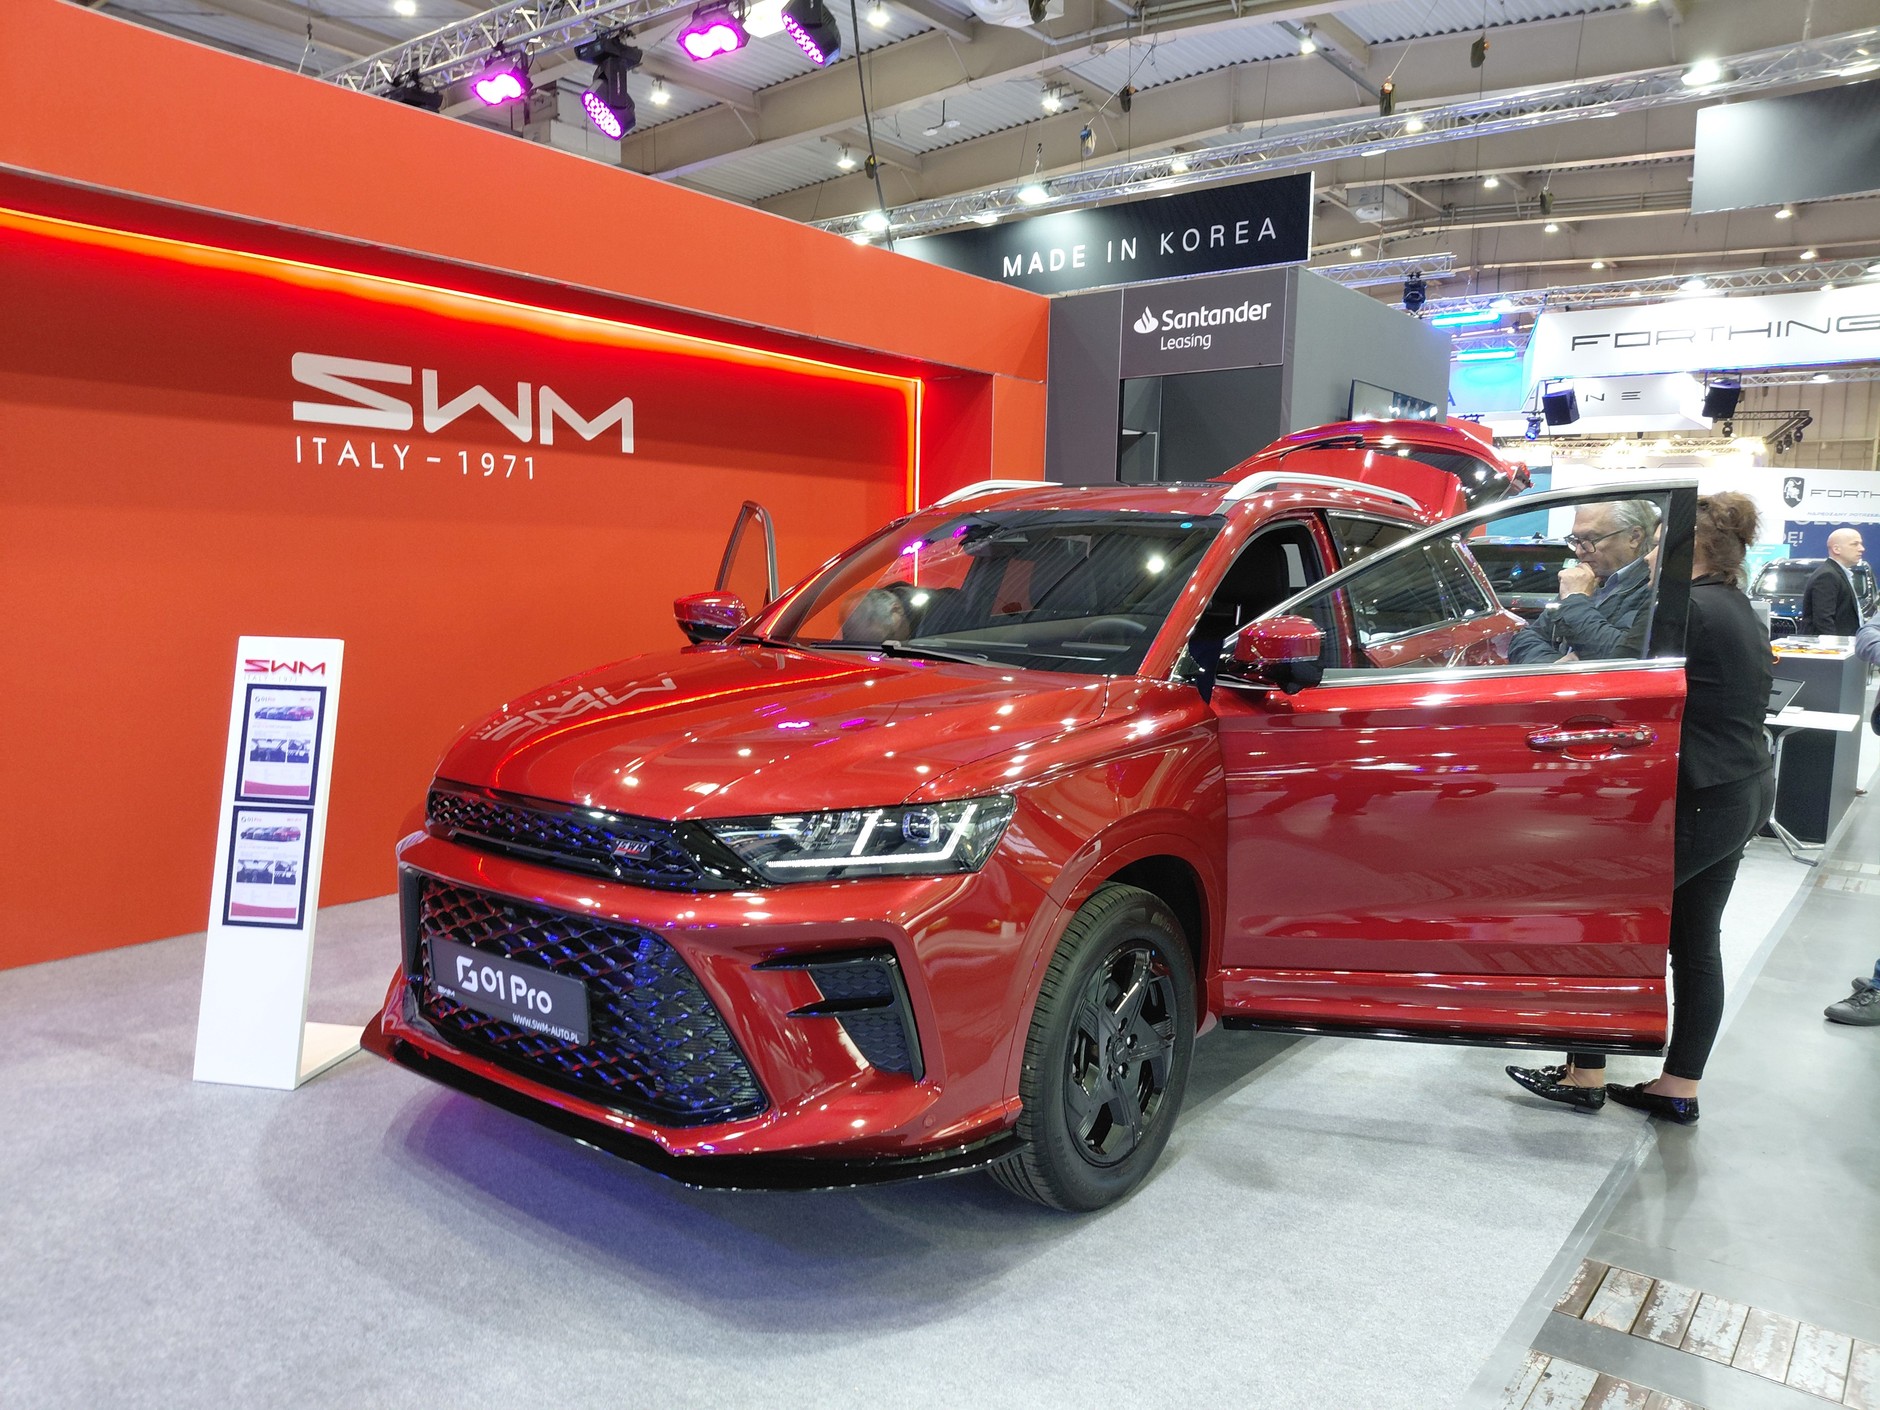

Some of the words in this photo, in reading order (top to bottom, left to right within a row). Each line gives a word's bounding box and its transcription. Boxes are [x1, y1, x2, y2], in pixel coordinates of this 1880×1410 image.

[1002, 244, 1086, 278] MADE
[1107, 237, 1137, 263] IN
[1160, 217, 1277, 256] KOREA
[1161, 300, 1272, 331] Santander
[1571, 313, 1880, 352] FORTHING
[1160, 333, 1212, 351] Leasing
[291, 351, 635, 454] SWM
[296, 434, 410, 471] ITALY
[458, 450, 534, 480] 1971
[244, 659, 326, 676] SWM
[510, 974, 553, 1015] Pro
[512, 1012, 580, 1045] WWW.SWM-AUTO.PL
